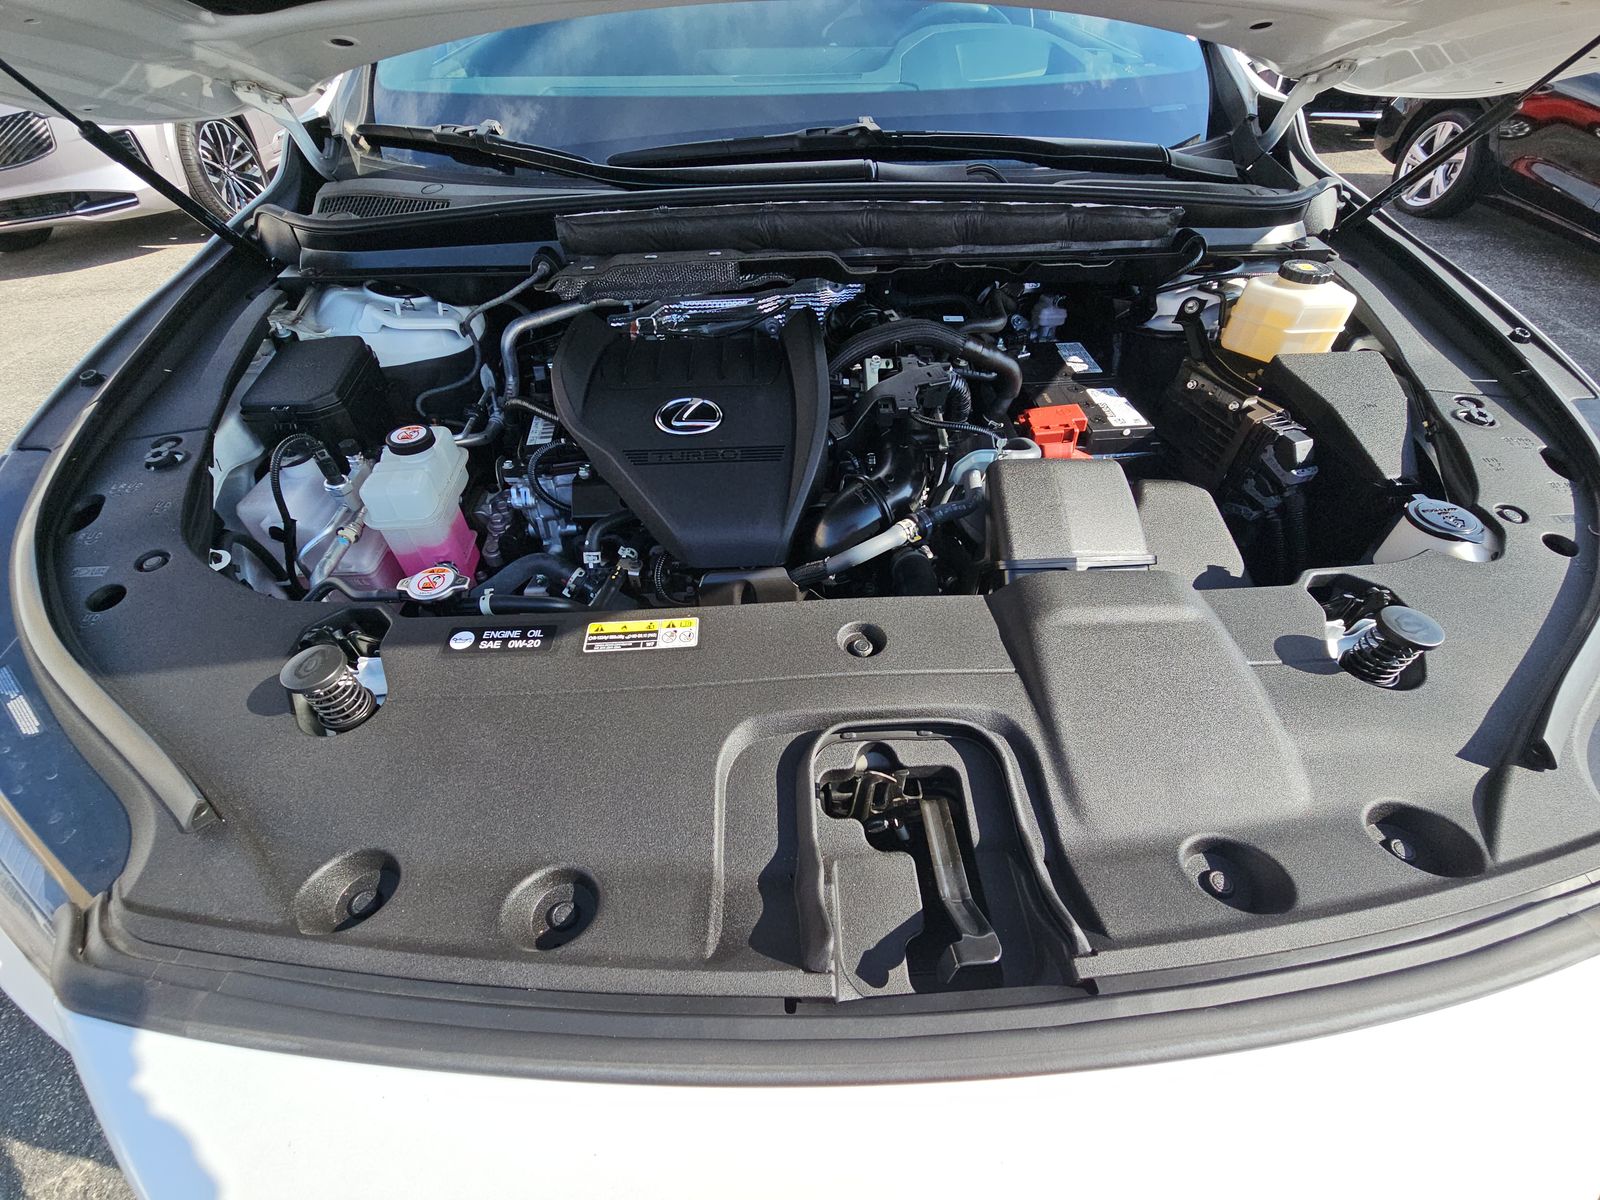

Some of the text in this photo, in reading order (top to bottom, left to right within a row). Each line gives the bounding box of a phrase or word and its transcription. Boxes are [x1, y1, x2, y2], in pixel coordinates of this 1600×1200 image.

[653, 448, 739, 462] TURBO
[482, 629, 544, 639] ENGINE OIL
[478, 639, 542, 649] SAE 0W-20
